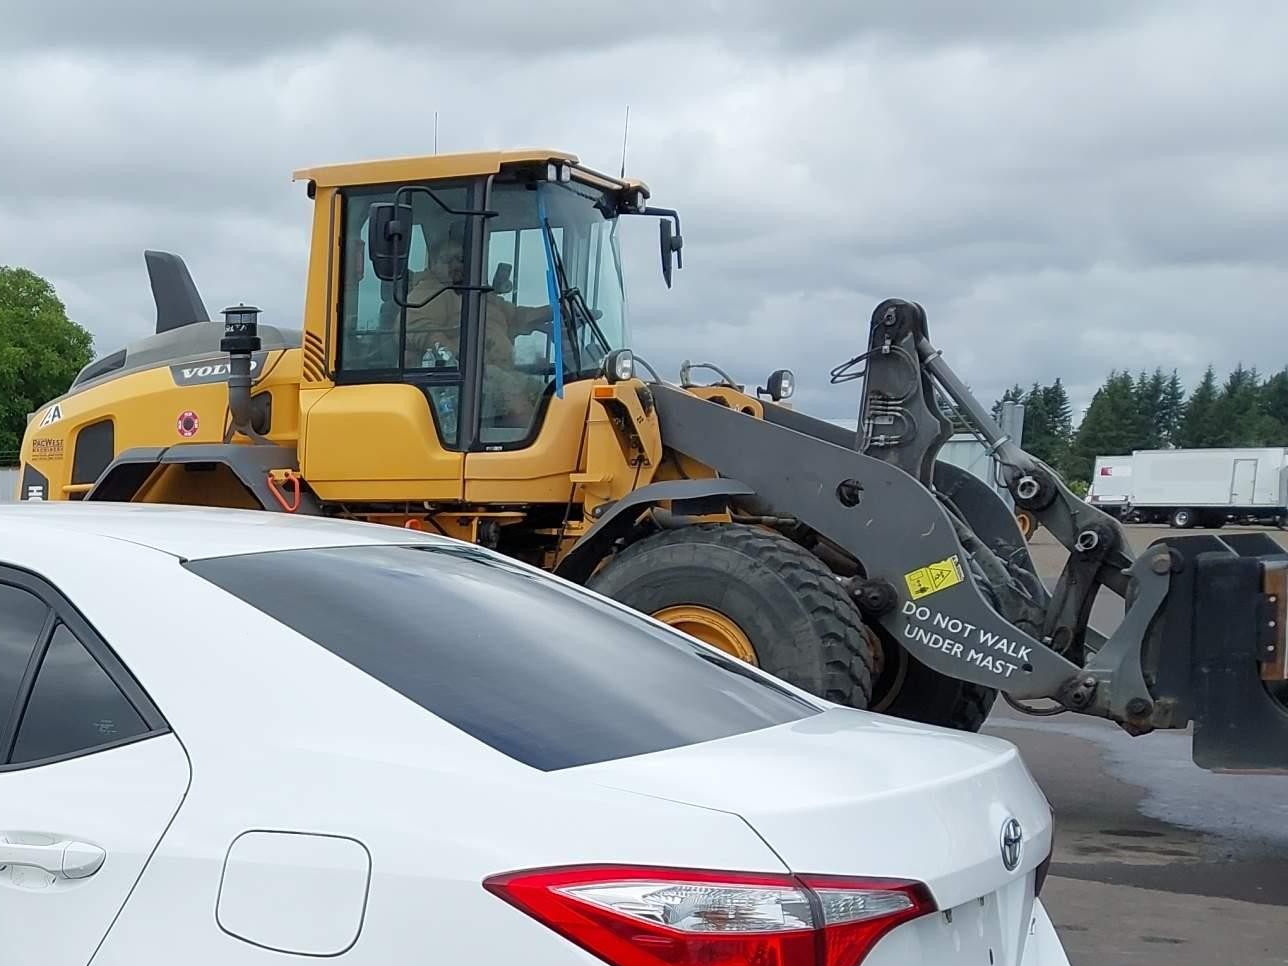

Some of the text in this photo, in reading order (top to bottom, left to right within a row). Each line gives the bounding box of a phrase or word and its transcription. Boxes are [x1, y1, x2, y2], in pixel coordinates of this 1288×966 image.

[902, 600, 1032, 662] DO NOT WALK
[904, 623, 1018, 678] UNDER MAST
